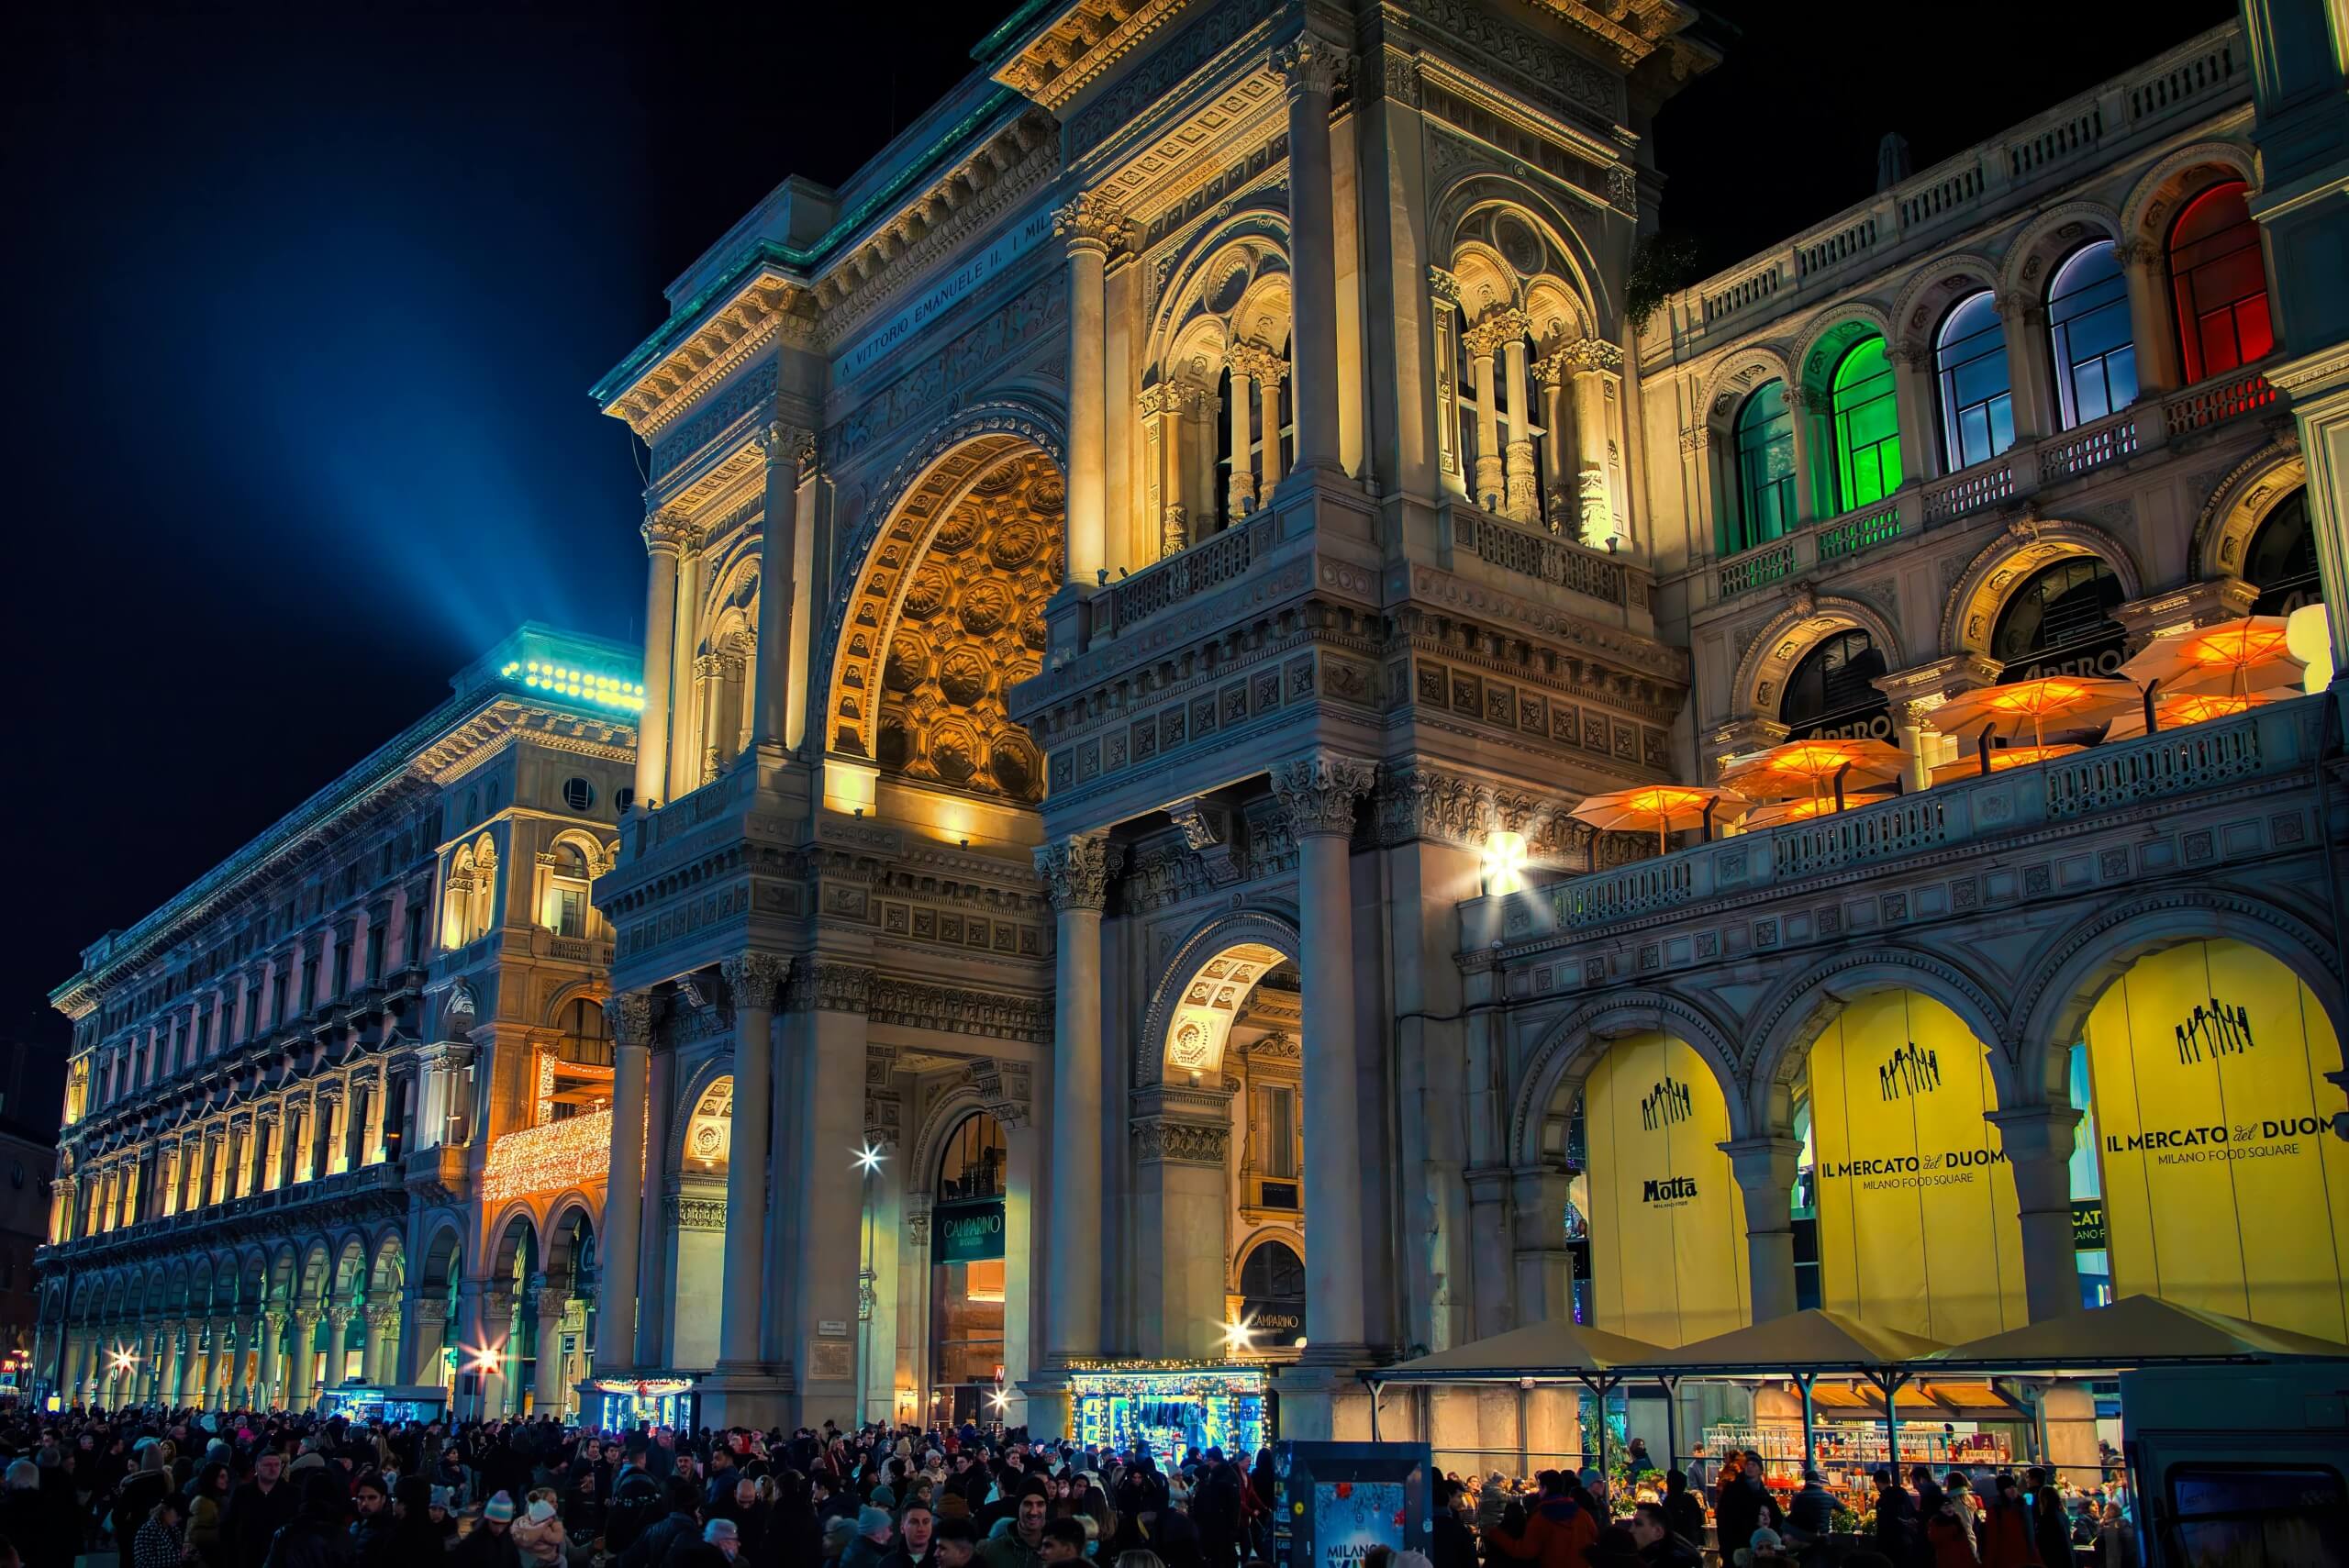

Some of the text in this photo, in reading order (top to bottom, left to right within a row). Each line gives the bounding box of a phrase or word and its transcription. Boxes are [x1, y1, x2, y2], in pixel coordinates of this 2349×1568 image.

[842, 361, 850, 377] A
[856, 317, 908, 364] VITTORIO
[915, 261, 983, 323] EMANUELE
[2107, 1136, 2123, 1152] IL
[2128, 1127, 2228, 1151] MERCATO
[2233, 1123, 2258, 1142] del
[1822, 1149, 2005, 1178] IL MERCATO del DUOM
[2158, 1143, 2299, 1165] MILANO FOOD SQUARE
[1642, 1176, 1698, 1203] Motta
[1863, 1173, 1974, 1190] MILANO FOOD SQUARE
[943, 1215, 1001, 1238] CAMPARINO
[1250, 1313, 1299, 1329] CAMPARINO
